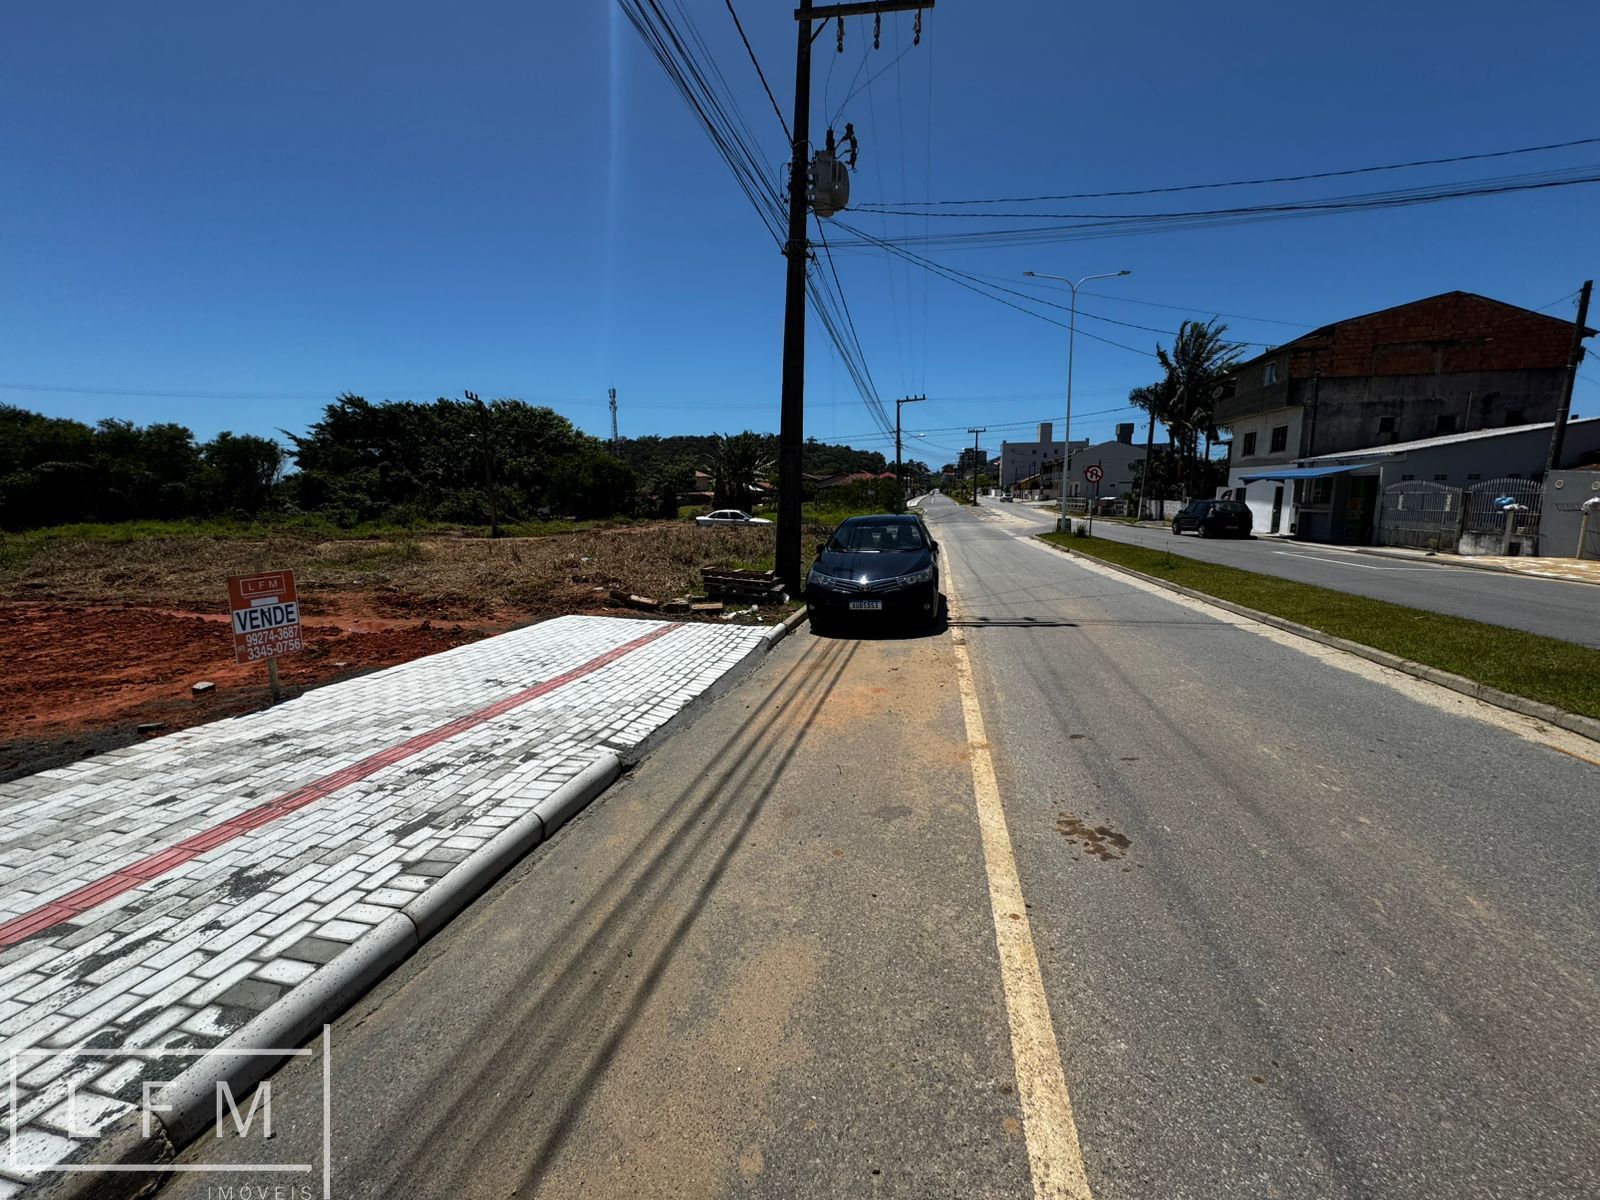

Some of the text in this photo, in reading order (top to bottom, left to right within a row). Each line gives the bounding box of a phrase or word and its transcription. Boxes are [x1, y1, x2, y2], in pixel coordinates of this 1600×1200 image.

[248, 579, 278, 591] LFM
[235, 603, 296, 631] VENDE
[246, 625, 299, 646] 99274-3687
[247, 638, 301, 660] 3345-0756
